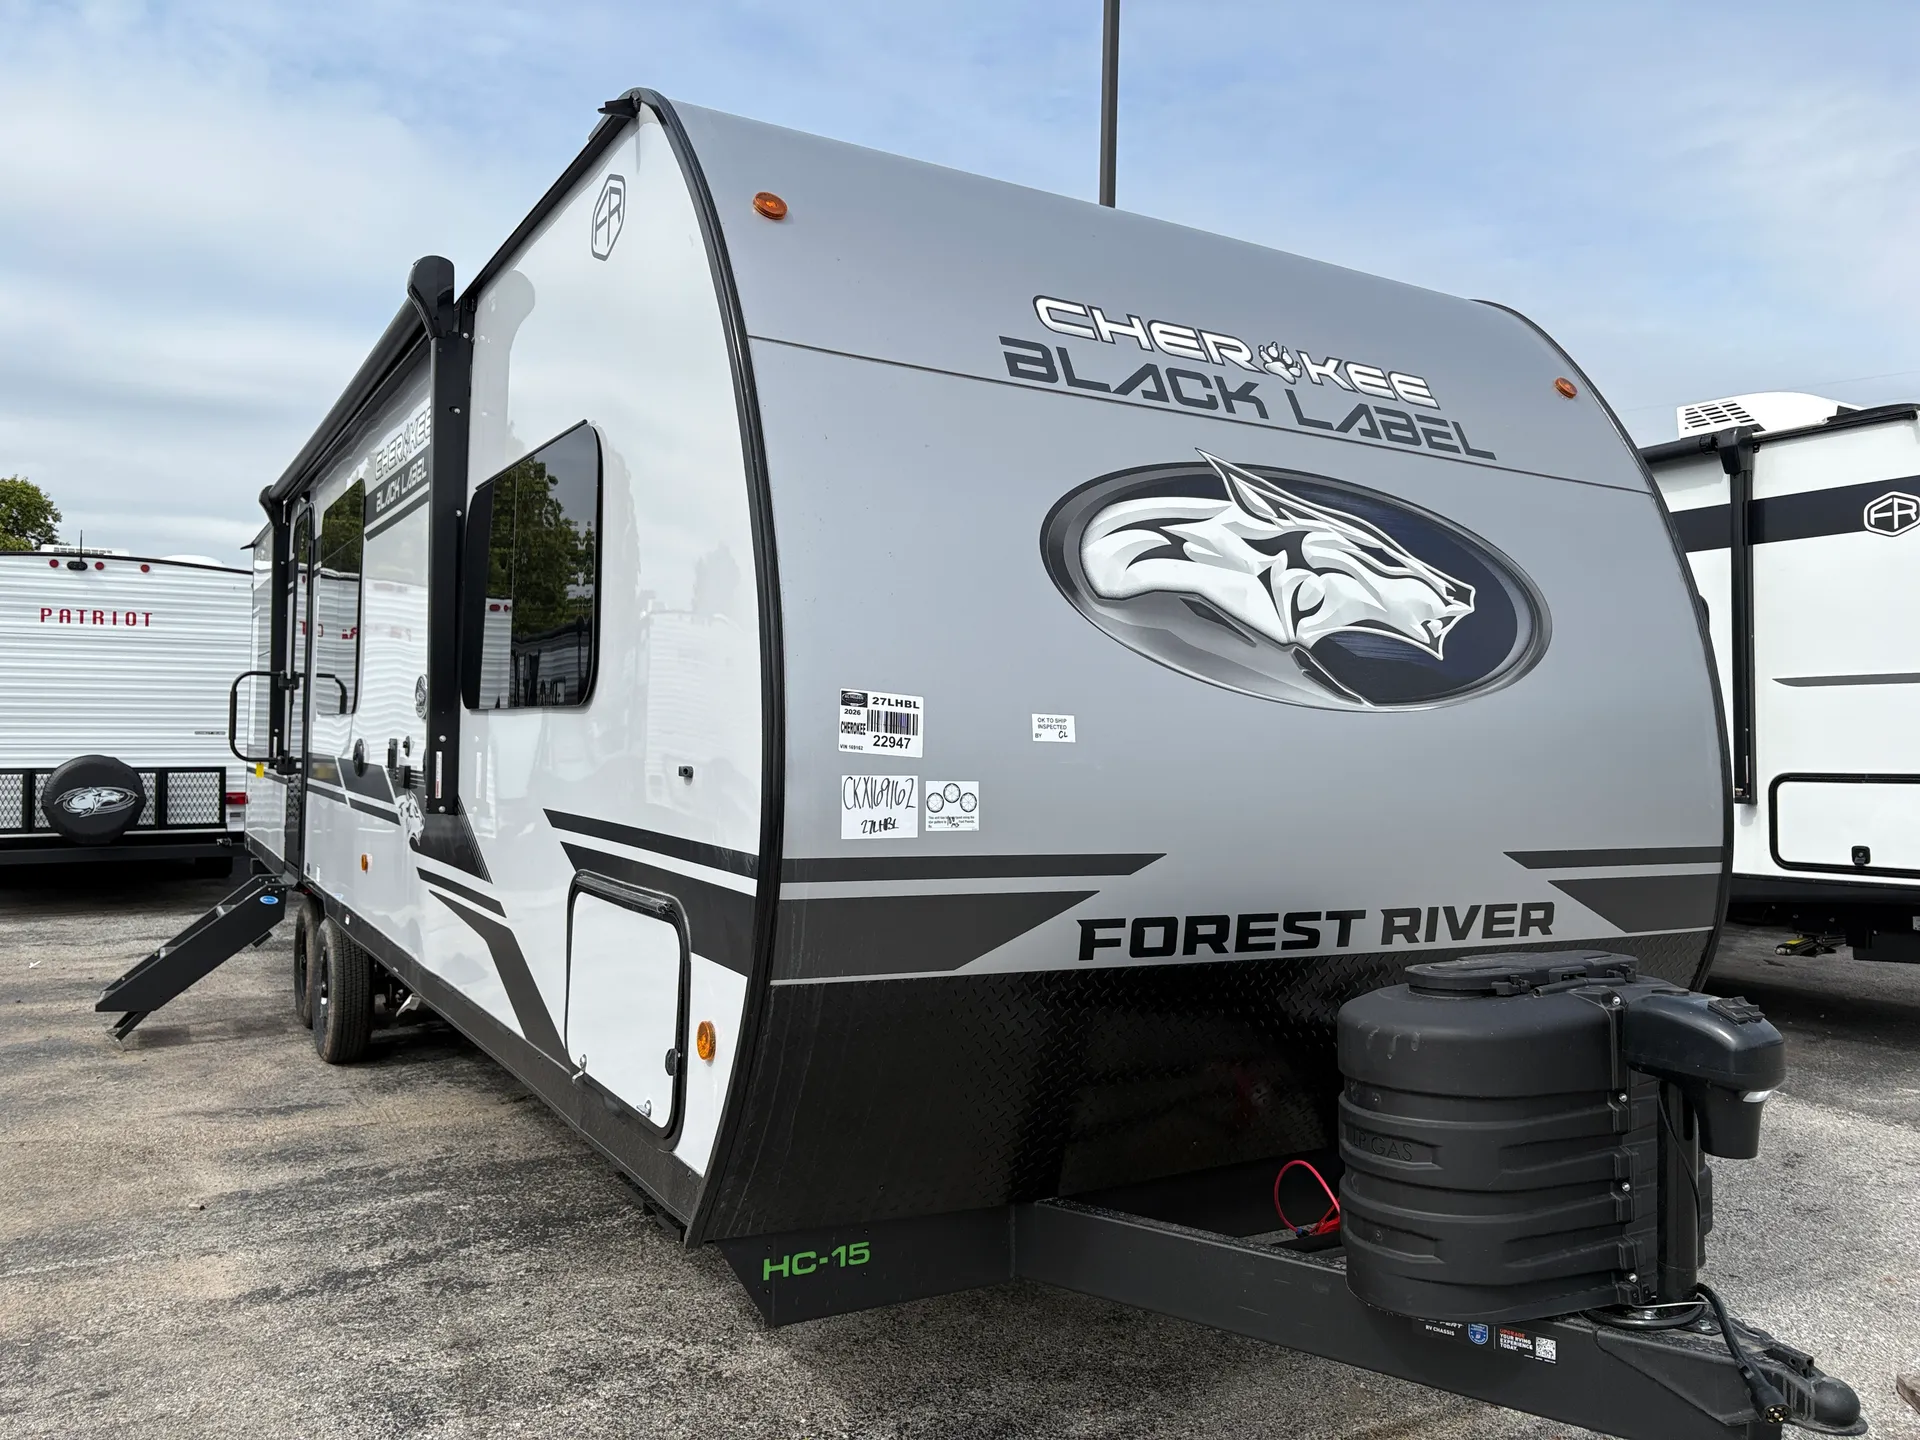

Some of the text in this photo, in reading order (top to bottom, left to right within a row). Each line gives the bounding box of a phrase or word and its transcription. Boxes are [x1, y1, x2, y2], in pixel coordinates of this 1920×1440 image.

[999, 335, 1497, 460] BLACK LABEL
[376, 457, 427, 513] BLACK LABEL
[40, 607, 153, 627] PATRIOT
[872, 696, 920, 709] 27LHBL
[844, 708, 861, 716] 2026
[841, 721, 866, 735] CHEROKEE
[873, 735, 911, 749] 22947
[843, 776, 916, 810] CKX169162
[1076, 901, 1555, 961] FOREST RIVER
[1371, 1135, 1412, 1161] GAS
[762, 1241, 871, 1281] HC-15
[1433, 1326, 1455, 1336] CHASSIS
[1500, 1328, 1526, 1337] UPGRADE
[1500, 1333, 1514, 1341] YOUR
[1500, 1338, 1533, 1350] EXPERIENCE
